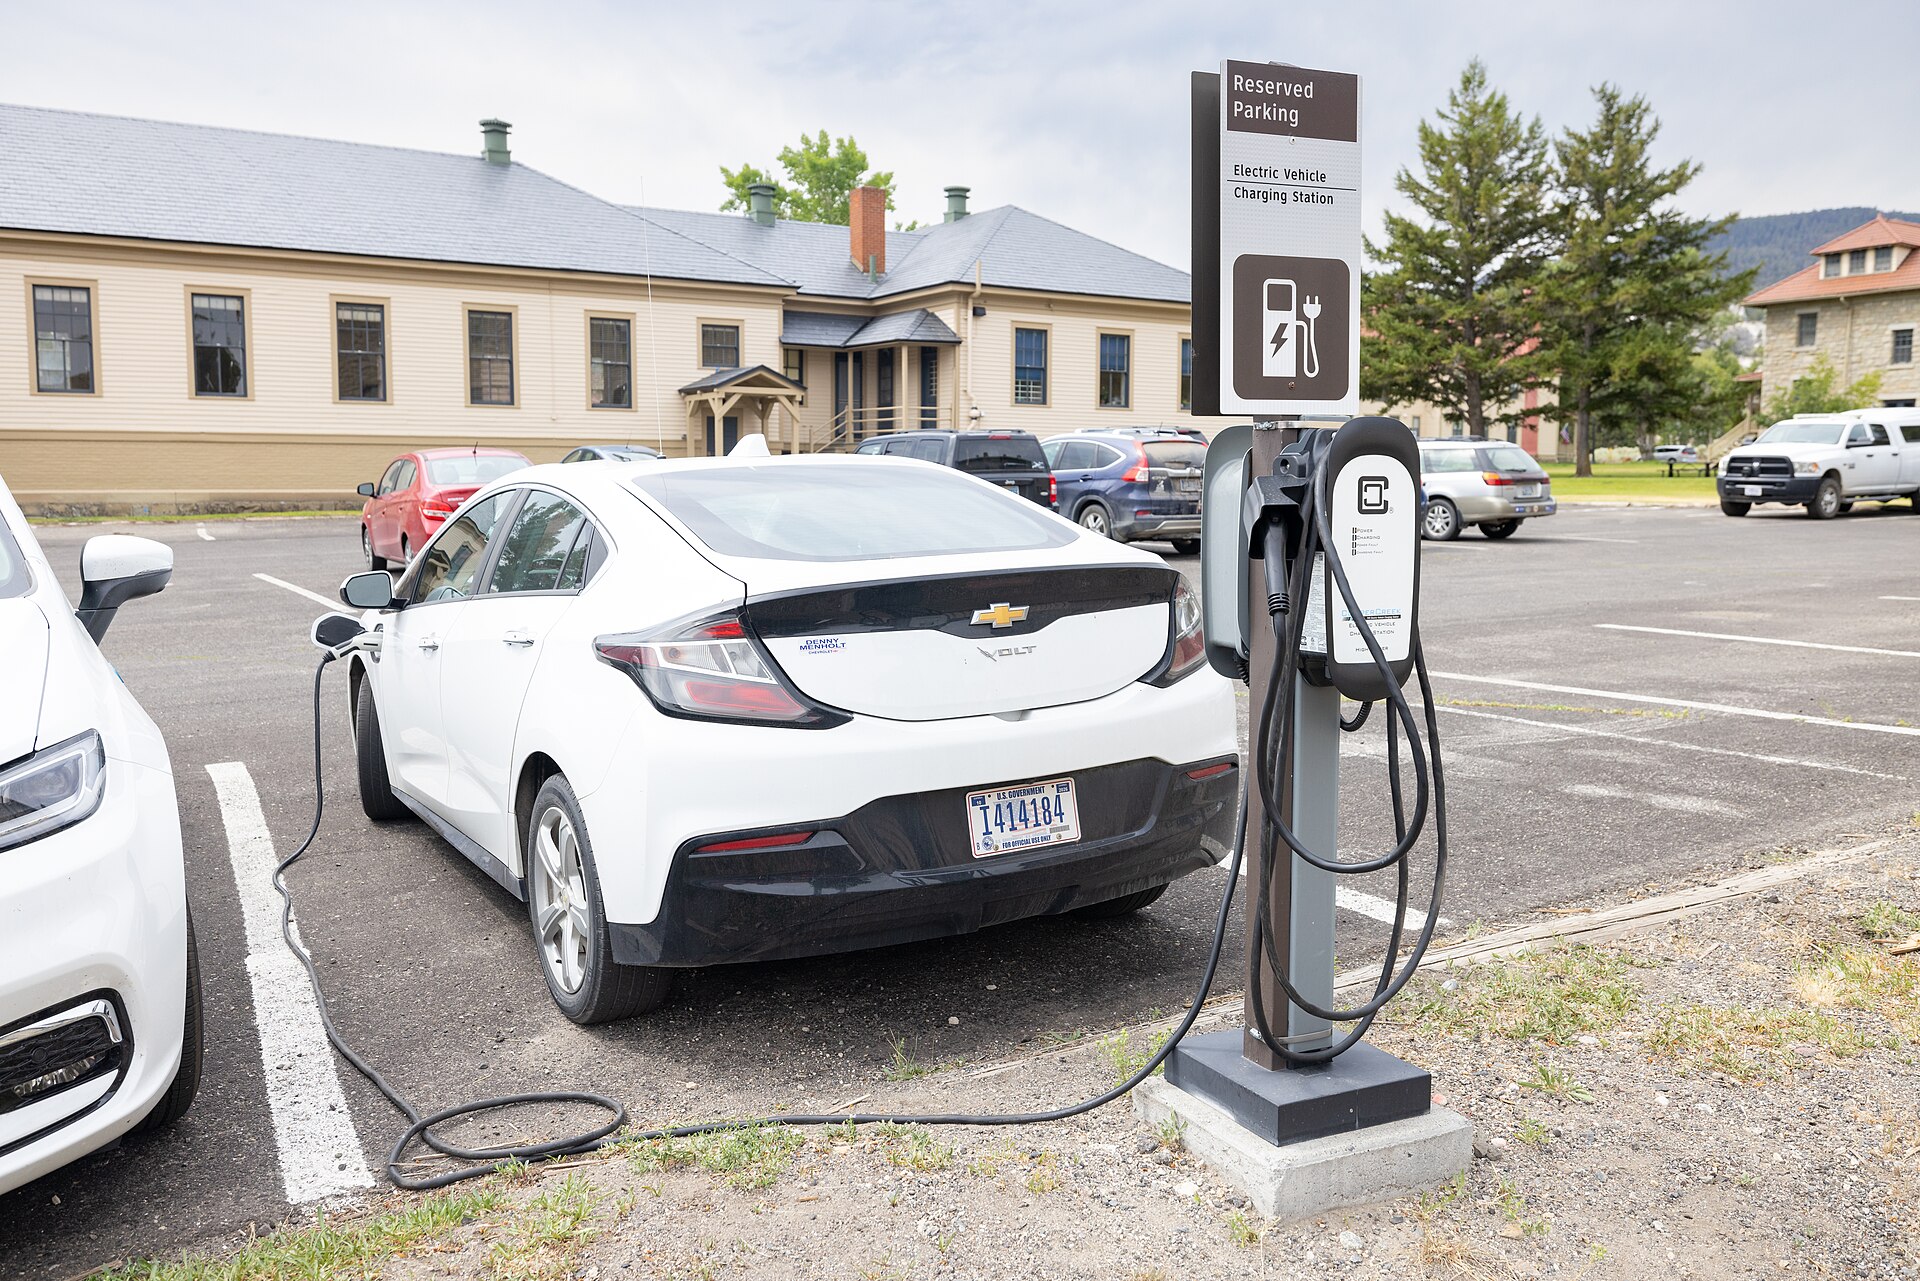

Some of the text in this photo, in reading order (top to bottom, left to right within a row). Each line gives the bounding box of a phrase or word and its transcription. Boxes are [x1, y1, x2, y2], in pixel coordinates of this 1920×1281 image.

[1234, 74, 1314, 99] Reserved
[1234, 101, 1299, 127] Parking
[1234, 164, 1326, 183] Electric Vehicle
[1234, 186, 1334, 205] Charging Station
[800, 642, 846, 650] MENHOLT
[977, 645, 1037, 662] VOLT
[997, 786, 1045, 800] U.S. GOVERNMENT
[979, 794, 1065, 836] I414184
[1012, 838, 1031, 848] OFFICIAL
